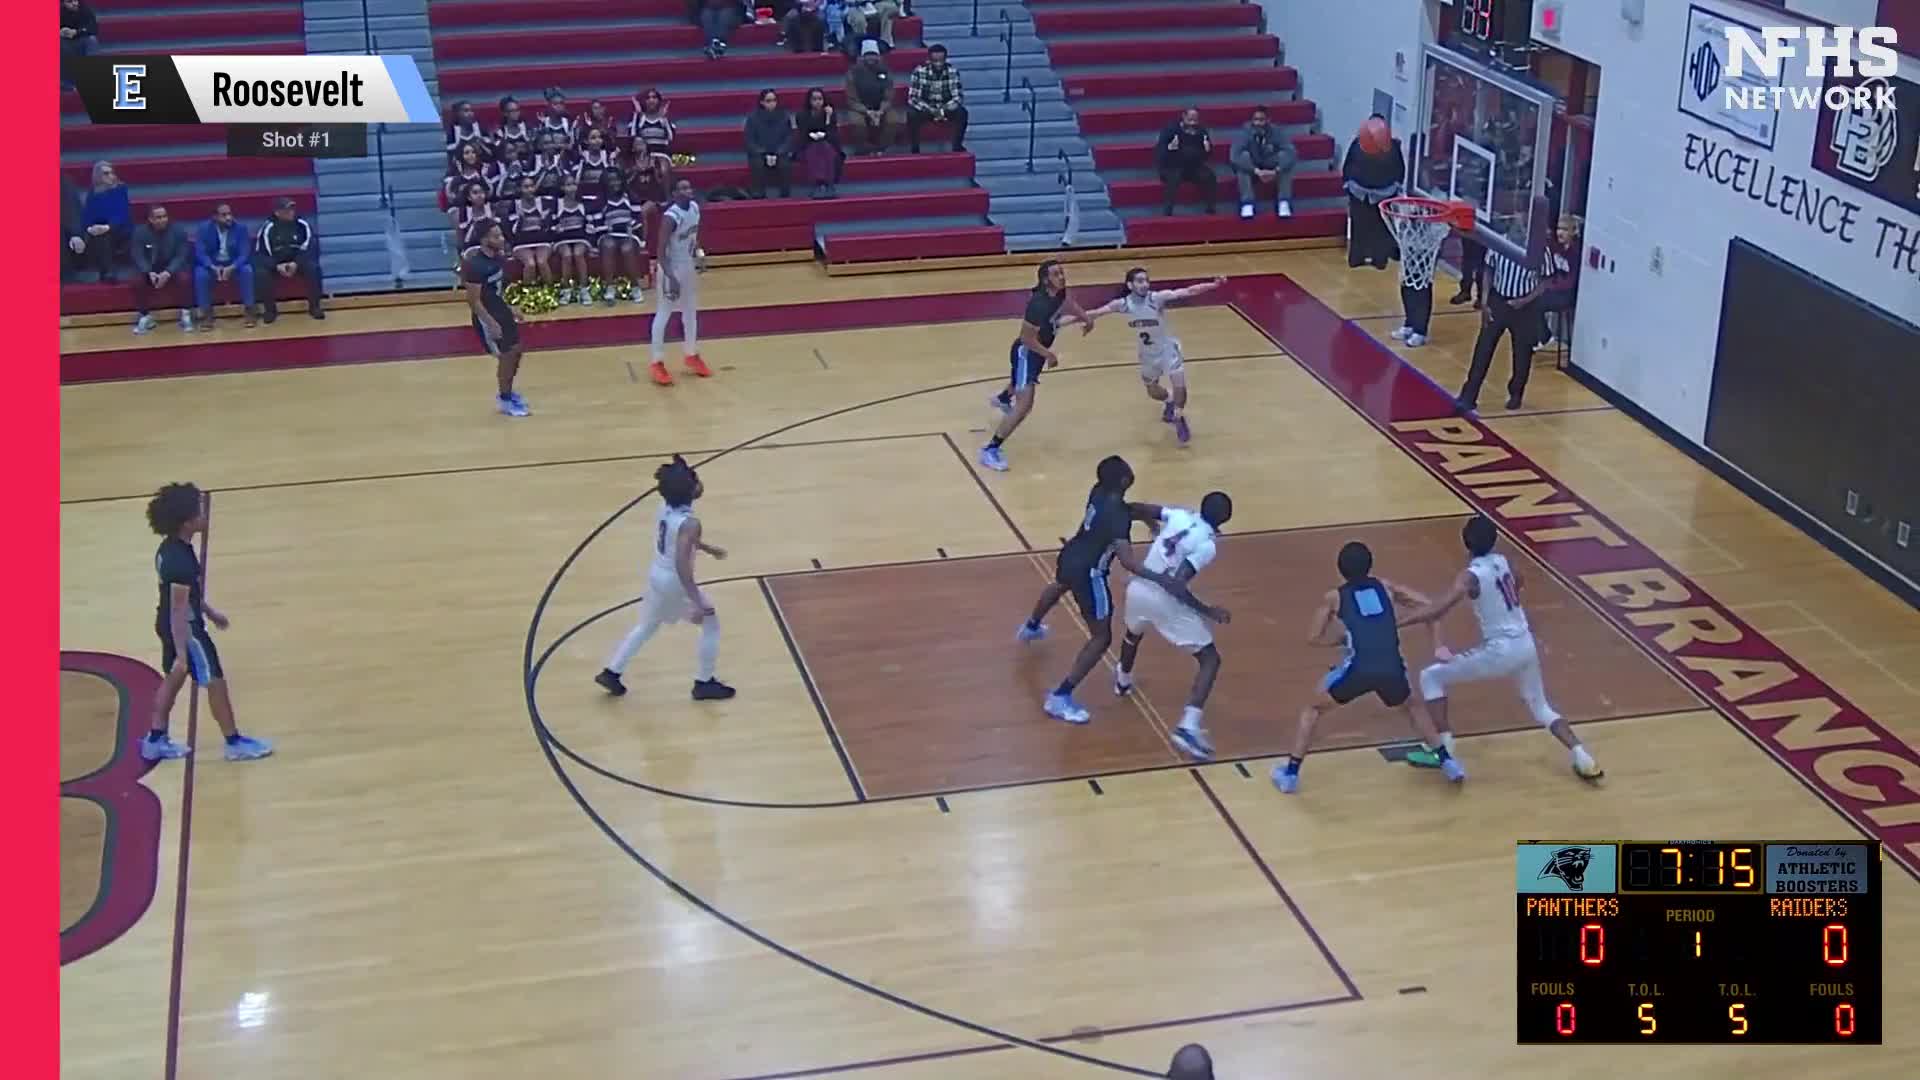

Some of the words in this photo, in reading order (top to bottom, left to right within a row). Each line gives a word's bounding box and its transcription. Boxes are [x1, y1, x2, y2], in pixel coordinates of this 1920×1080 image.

[1685, 133, 1861, 243] EXCELLENCE
[1876, 216, 1920, 274] TH
[1140, 332, 1154, 345] 2
[1390, 417, 1629, 548] PAINT
